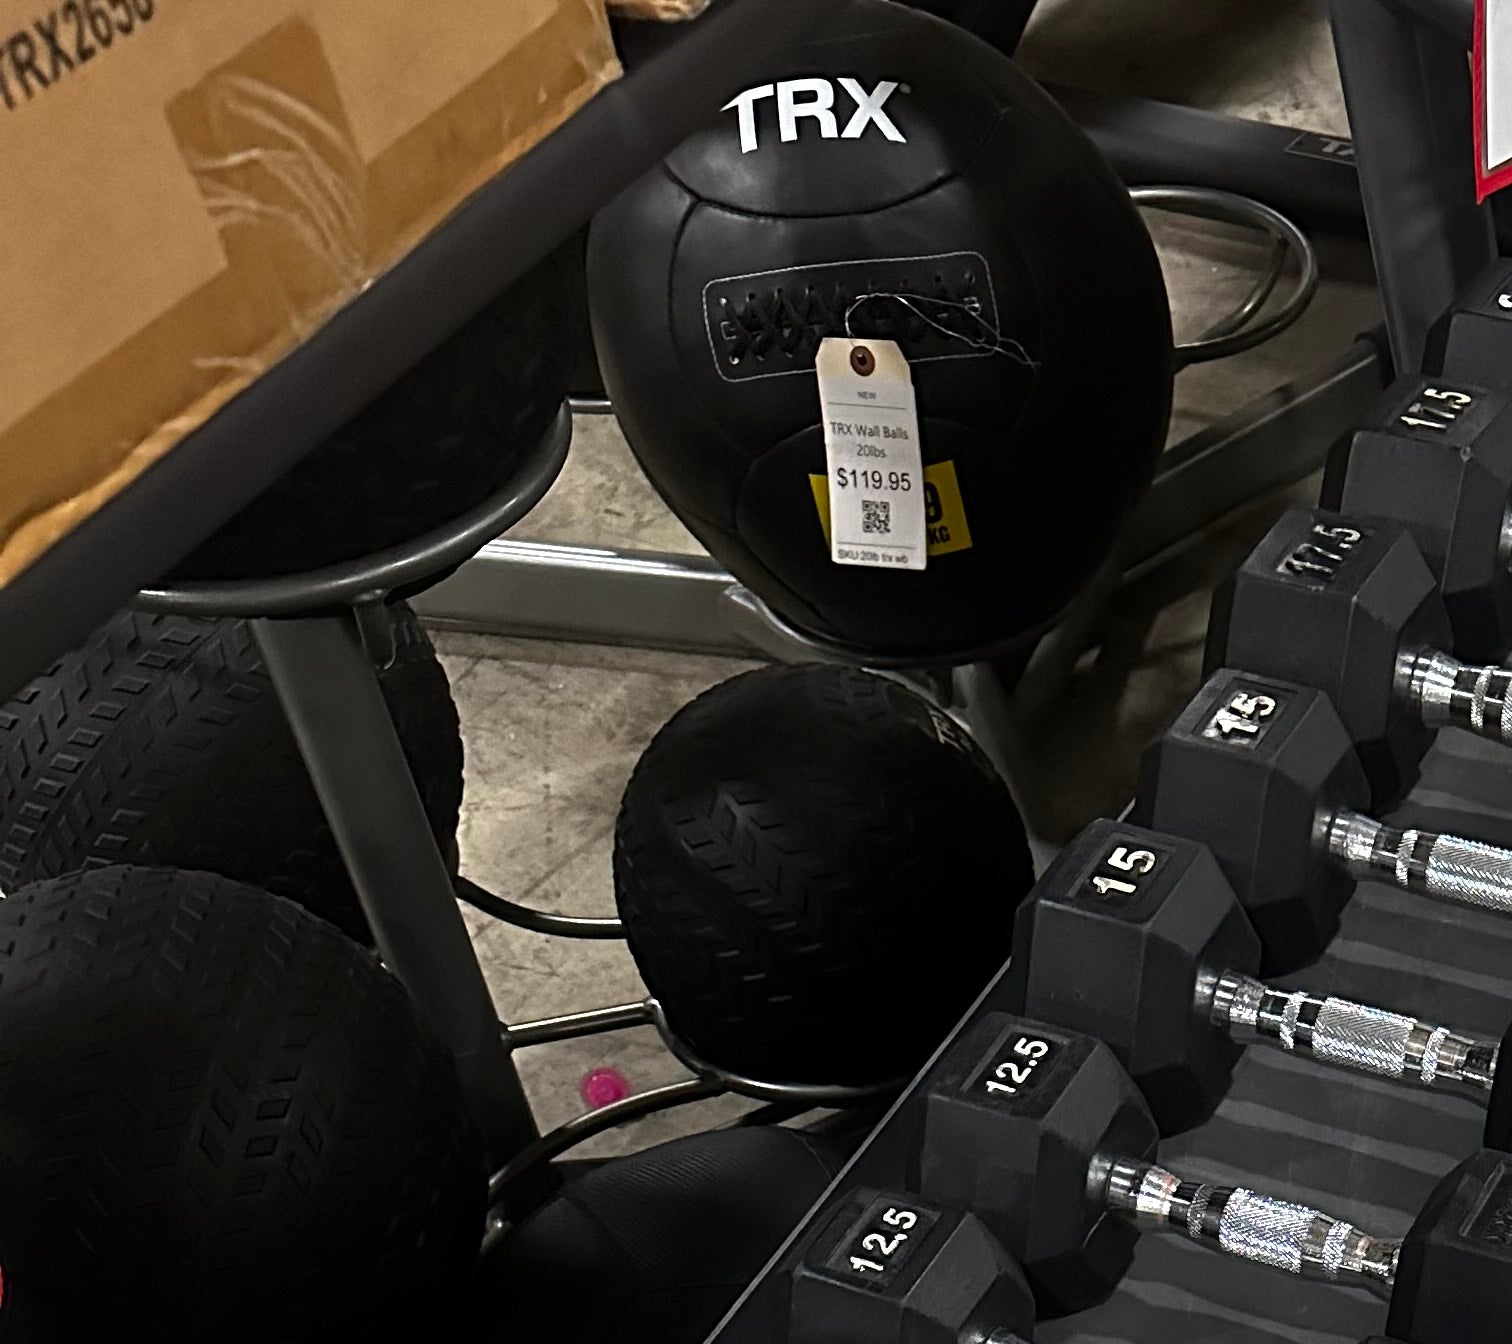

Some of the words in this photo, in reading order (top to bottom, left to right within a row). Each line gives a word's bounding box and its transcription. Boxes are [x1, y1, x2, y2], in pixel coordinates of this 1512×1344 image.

[722, 78, 906, 153] TRX
[830, 421, 852, 436] TRX
[855, 424, 880, 438] Wall
[883, 425, 909, 440] Balls
[1400, 388, 1472, 429] 17.5
[857, 443, 887, 458] 20lbs
[837, 467, 911, 491] $119.95
[1214, 691, 1277, 740] 15
[1093, 848, 1155, 893] 15
[987, 1038, 1048, 1092] 12.5
[850, 1208, 917, 1271] 12.5
